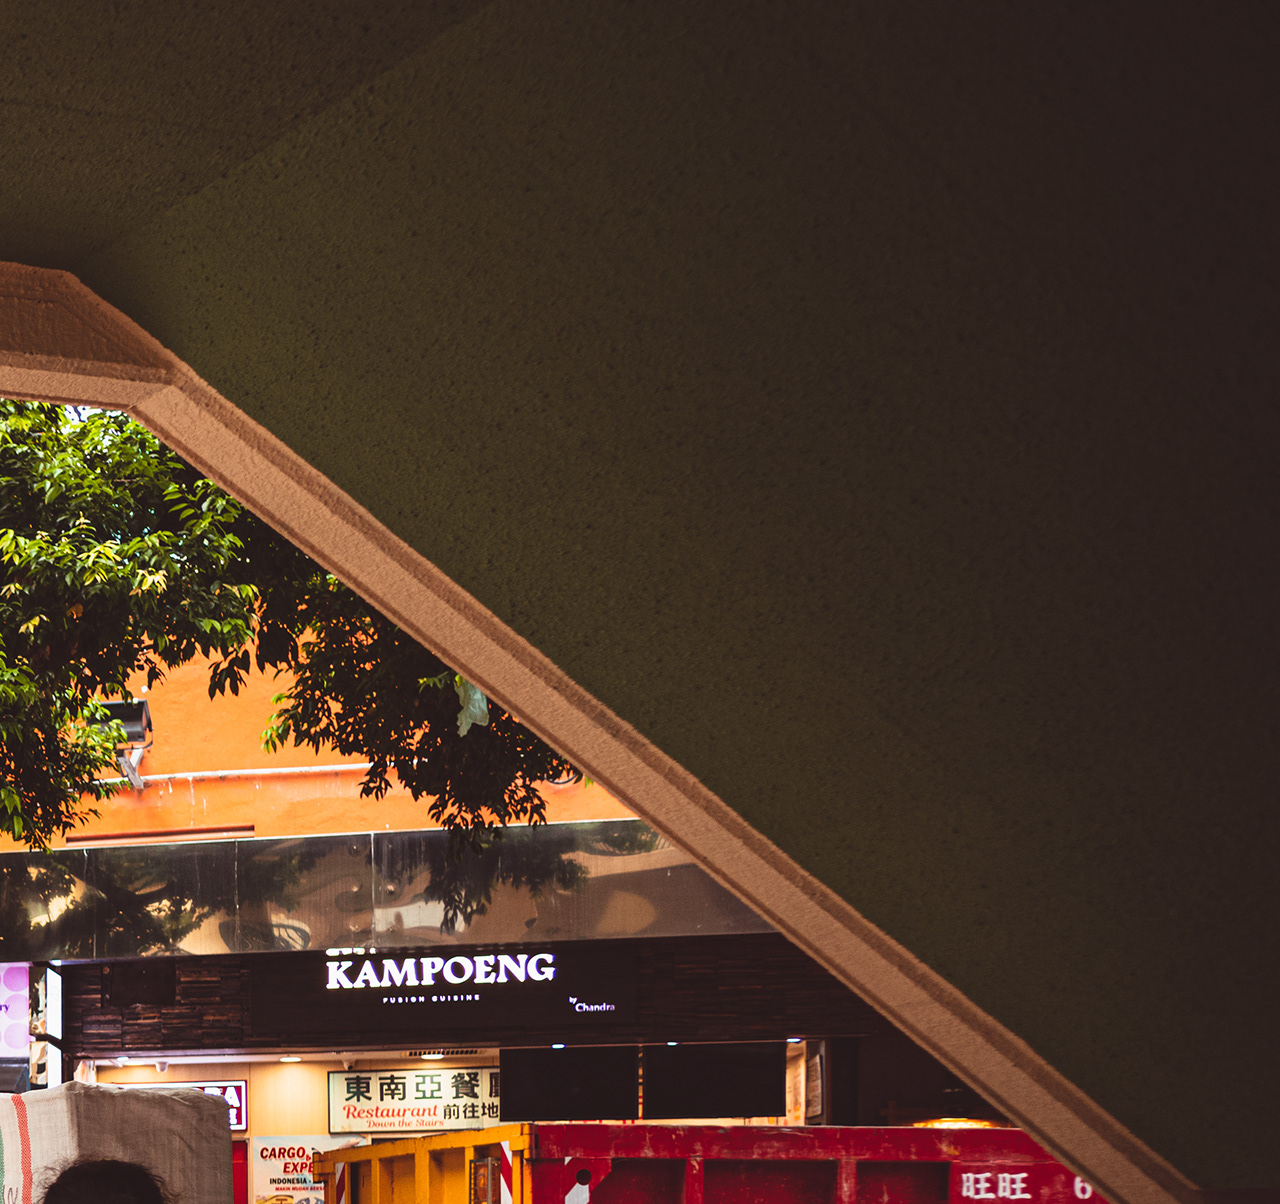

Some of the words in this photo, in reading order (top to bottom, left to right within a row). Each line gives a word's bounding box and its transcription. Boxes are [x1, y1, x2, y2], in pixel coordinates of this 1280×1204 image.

[325, 952, 556, 989] KAMPOENG
[382, 995, 425, 1004] FUSION
[431, 994, 481, 1003] CUISINE
[568, 996, 578, 1006] by
[575, 1001, 616, 1013] Chandra
[342, 1103, 438, 1120] Restaurant
[443, 1102, 499, 1120] 前往地
[366, 1119, 396, 1129] Down
[398, 1118, 413, 1128] the
[415, 1117, 444, 1127] Stairs
[259, 1146, 306, 1160] CARGO
[269, 1177, 307, 1185] INDONESIA
[961, 1172, 1032, 1199] 旺旺
